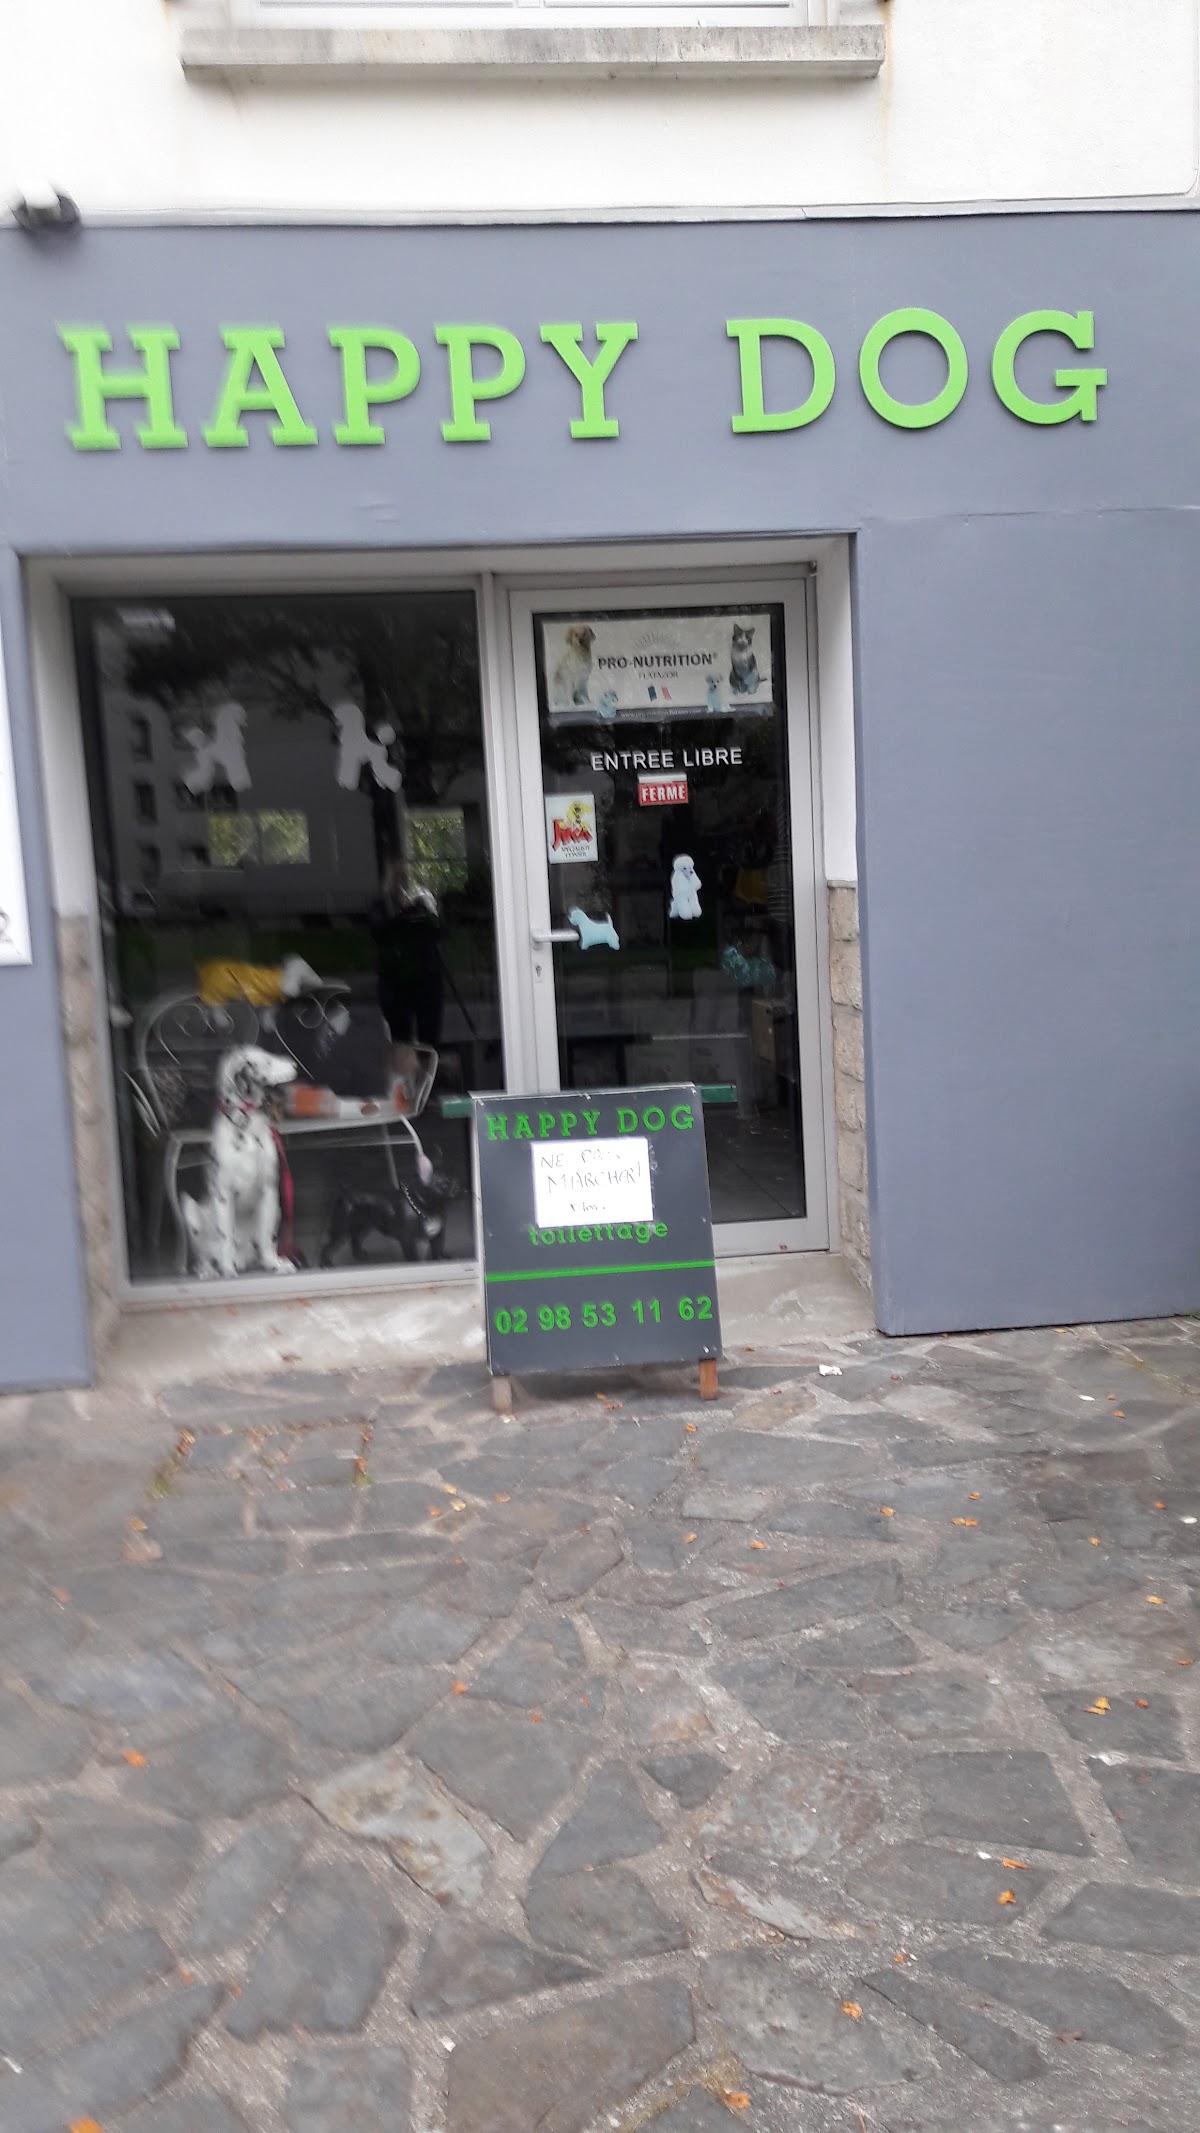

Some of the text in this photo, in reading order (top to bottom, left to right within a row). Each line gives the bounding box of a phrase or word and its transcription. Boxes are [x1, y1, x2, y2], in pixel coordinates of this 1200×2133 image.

[58, 308, 1108, 449] HAPPY DOG
[598, 652, 713, 670] PRO-NUTRITION
[590, 747, 743, 772] ENTREE LIBRE
[641, 786, 687, 803] FERME
[486, 1104, 695, 1141] HAPPY DOG
[540, 1153, 564, 1169] NE
[528, 1221, 669, 1246] toilettage
[495, 1295, 713, 1335] 02 98 53 11 62
